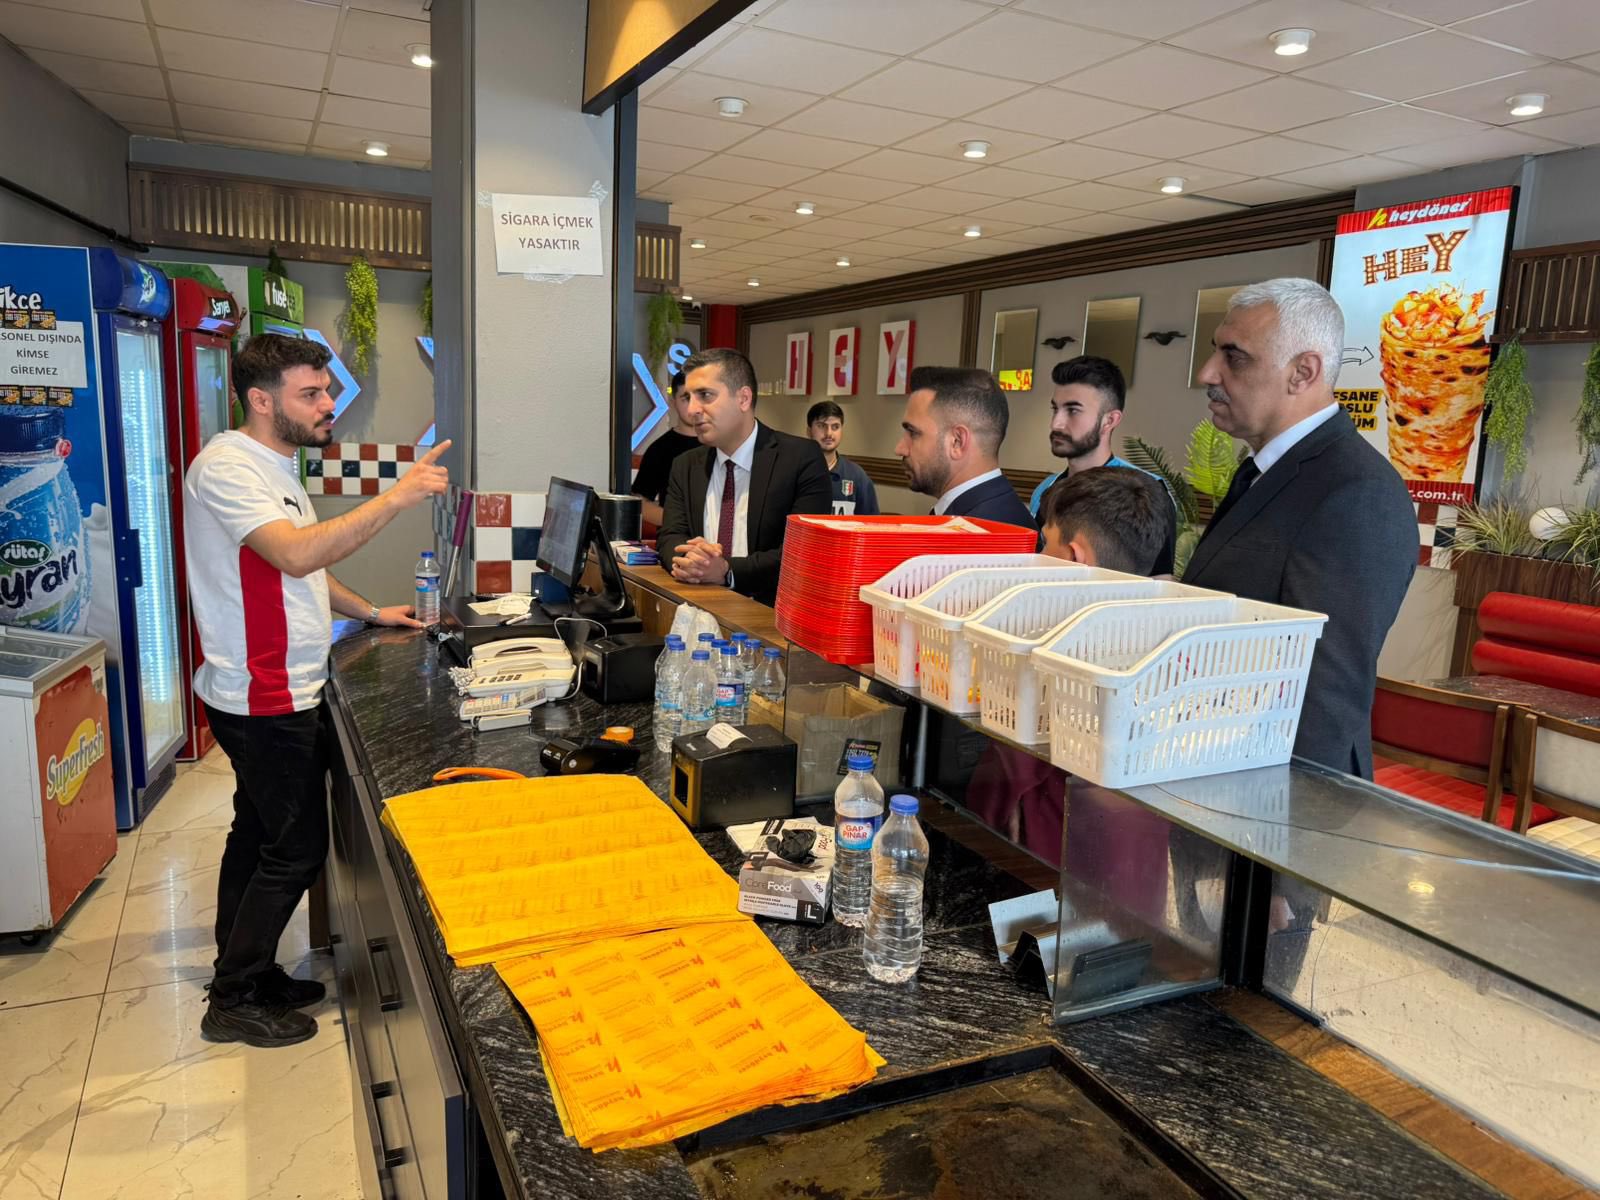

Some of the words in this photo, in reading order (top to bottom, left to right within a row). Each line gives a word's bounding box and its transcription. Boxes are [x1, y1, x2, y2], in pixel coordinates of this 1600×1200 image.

[1388, 198, 1472, 223] heydöner
[501, 212, 550, 227] SİGARA
[553, 213, 594, 230] İÇMEK
[518, 237, 581, 251] YASAKTIR
[1363, 228, 1471, 286] HEY
[1, 332, 36, 342] SONEL
[38, 333, 82, 345] DIŞINDA
[16, 347, 50, 359] KİMSE
[10, 364, 59, 376] GİREMEZ
[3, 543, 46, 561] sütaş
[47, 722, 104, 800] SuperFresh
[842, 830, 868, 840] PINAR
[845, 824, 864, 833] GAP
[807, 904, 817, 919] L
